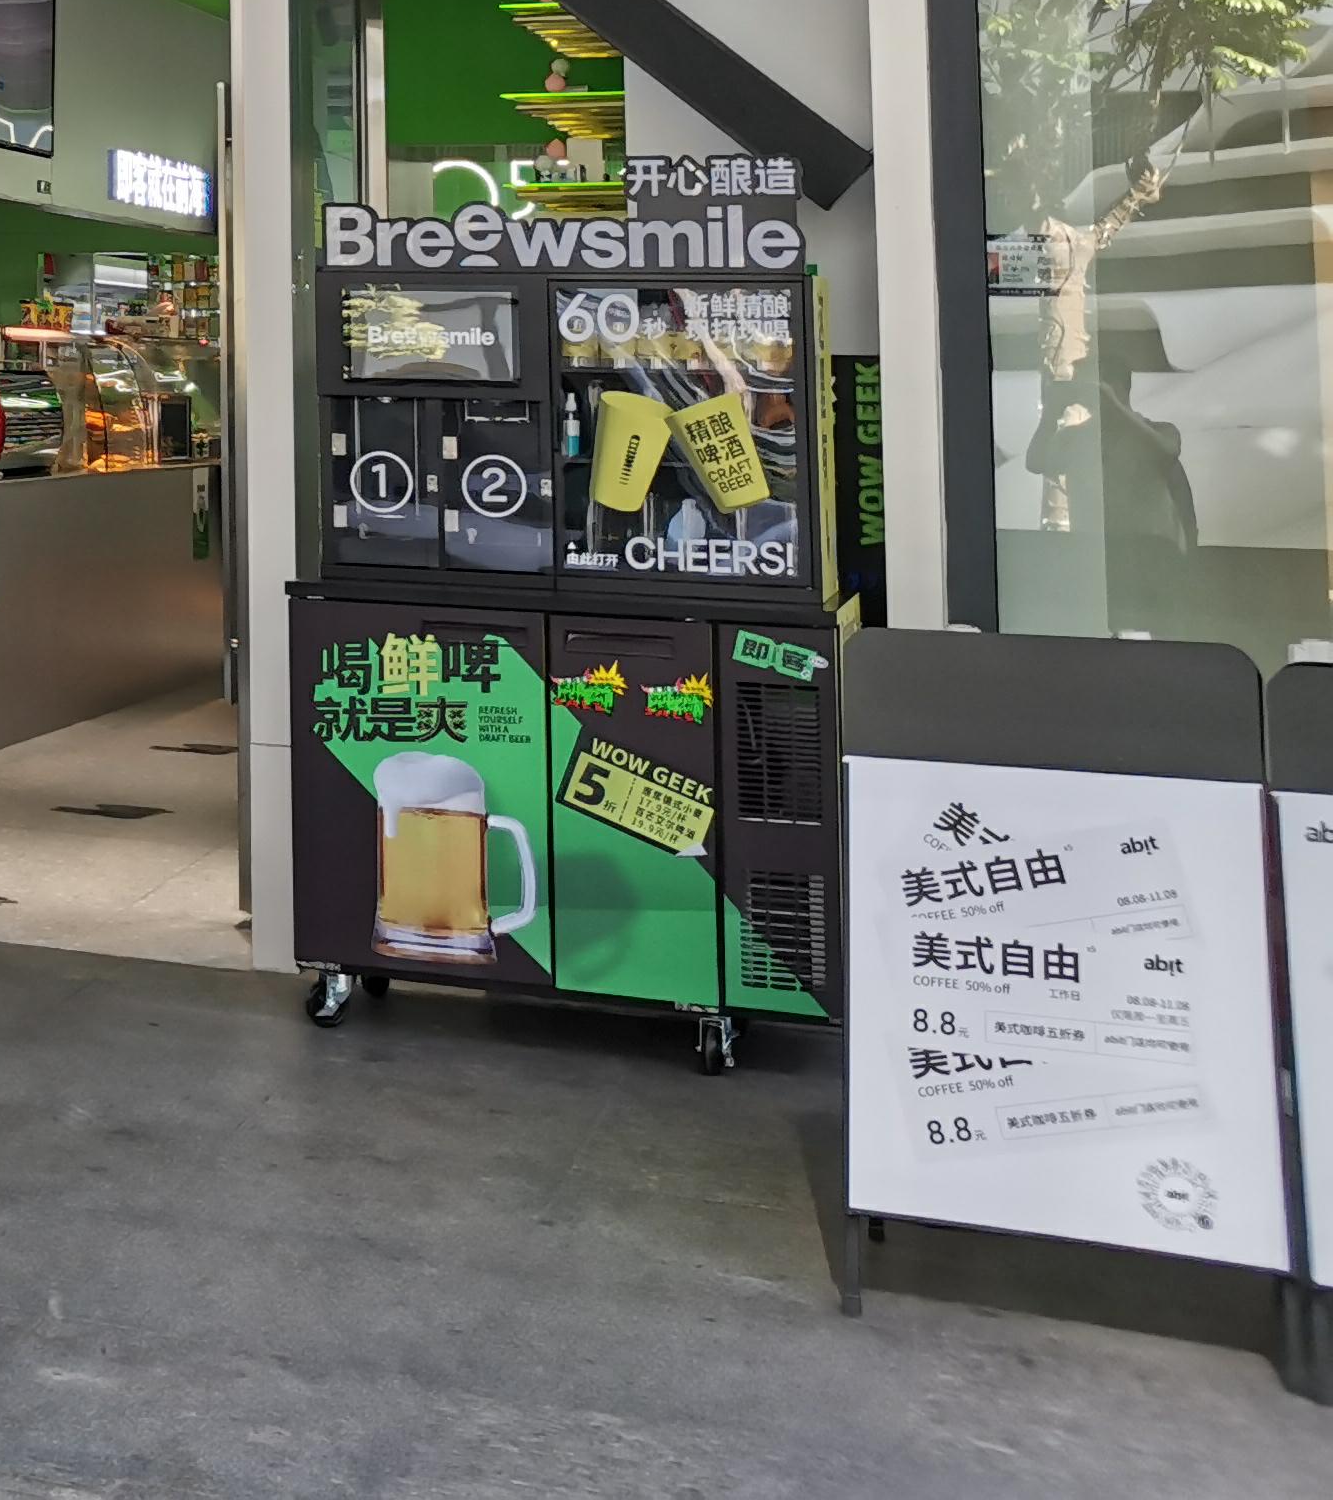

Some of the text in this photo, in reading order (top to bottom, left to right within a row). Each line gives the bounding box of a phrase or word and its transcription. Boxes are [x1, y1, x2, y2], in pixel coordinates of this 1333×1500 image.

[626, 156, 797, 199] 开心酿造
[685, 293, 790, 319] 新鲜精酿
[685, 410, 736, 446] 精酿
[695, 434, 746, 466] 啤酒
[854, 361, 886, 547] WOW GEEK
[708, 457, 754, 483] CRAFT
[718, 473, 755, 494] BEER
[625, 536, 796, 577] CHEERS!
[320, 632, 502, 696] 喝鲜啤
[312, 696, 470, 743] 就是爽
[478, 705, 518, 715] REFRESH
[478, 715, 524, 725] YOURSELF
[479, 734, 531, 744] DRAFT BEER
[590, 738, 714, 805] WOW GEEK
[901, 849, 1066, 907] 美式自由
[989, 900, 1005, 913] off
[912, 931, 1081, 984] 美式自由
[912, 975, 1011, 994] COFFEE 50% off
[918, 1074, 1014, 1098] COFFEE 50% off
